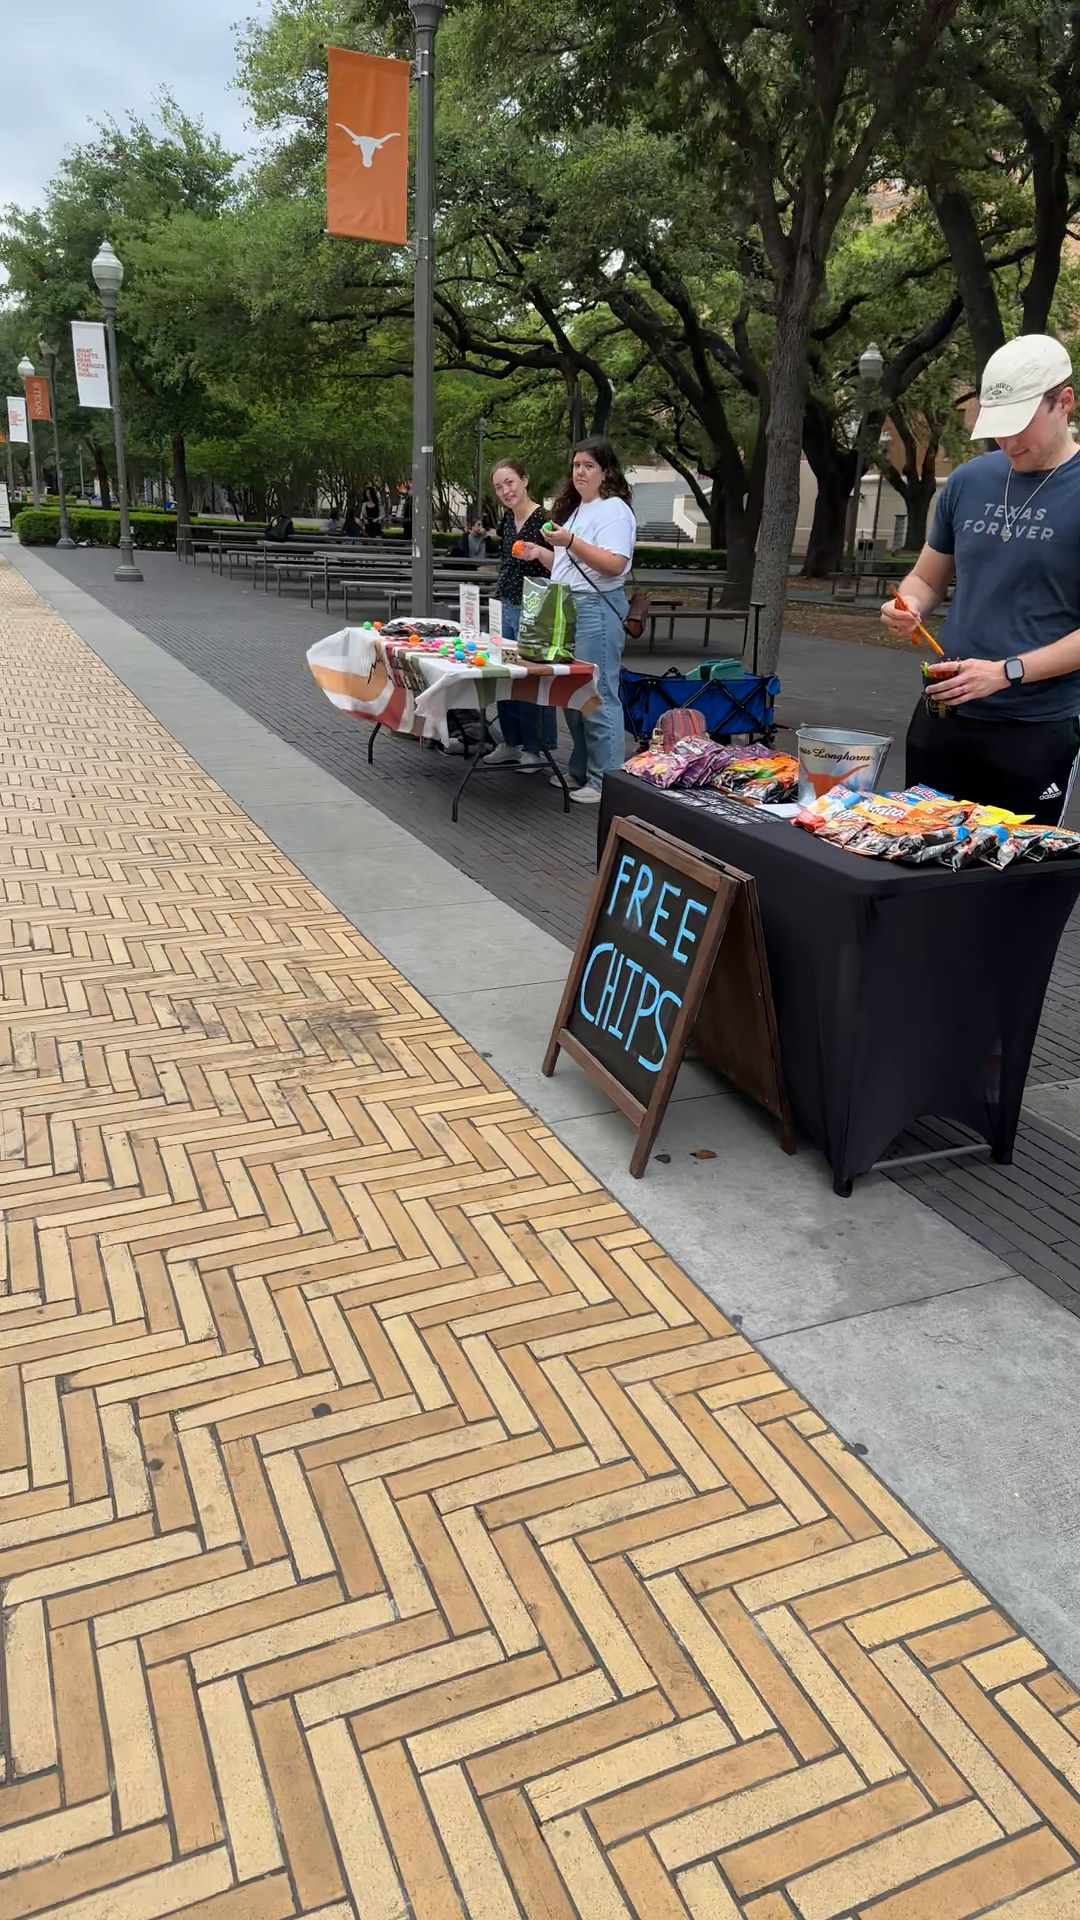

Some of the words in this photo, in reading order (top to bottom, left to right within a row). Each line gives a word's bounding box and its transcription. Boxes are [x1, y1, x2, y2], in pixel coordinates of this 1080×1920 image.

[34, 388, 43, 415] TEXAS
[984, 503, 1047, 521] TEXAS
[812, 748, 871, 763] Longhorns
[1039, 791, 1062, 801] adidas
[607, 854, 708, 965] FREE
[580, 942, 683, 1073] CHIPS
